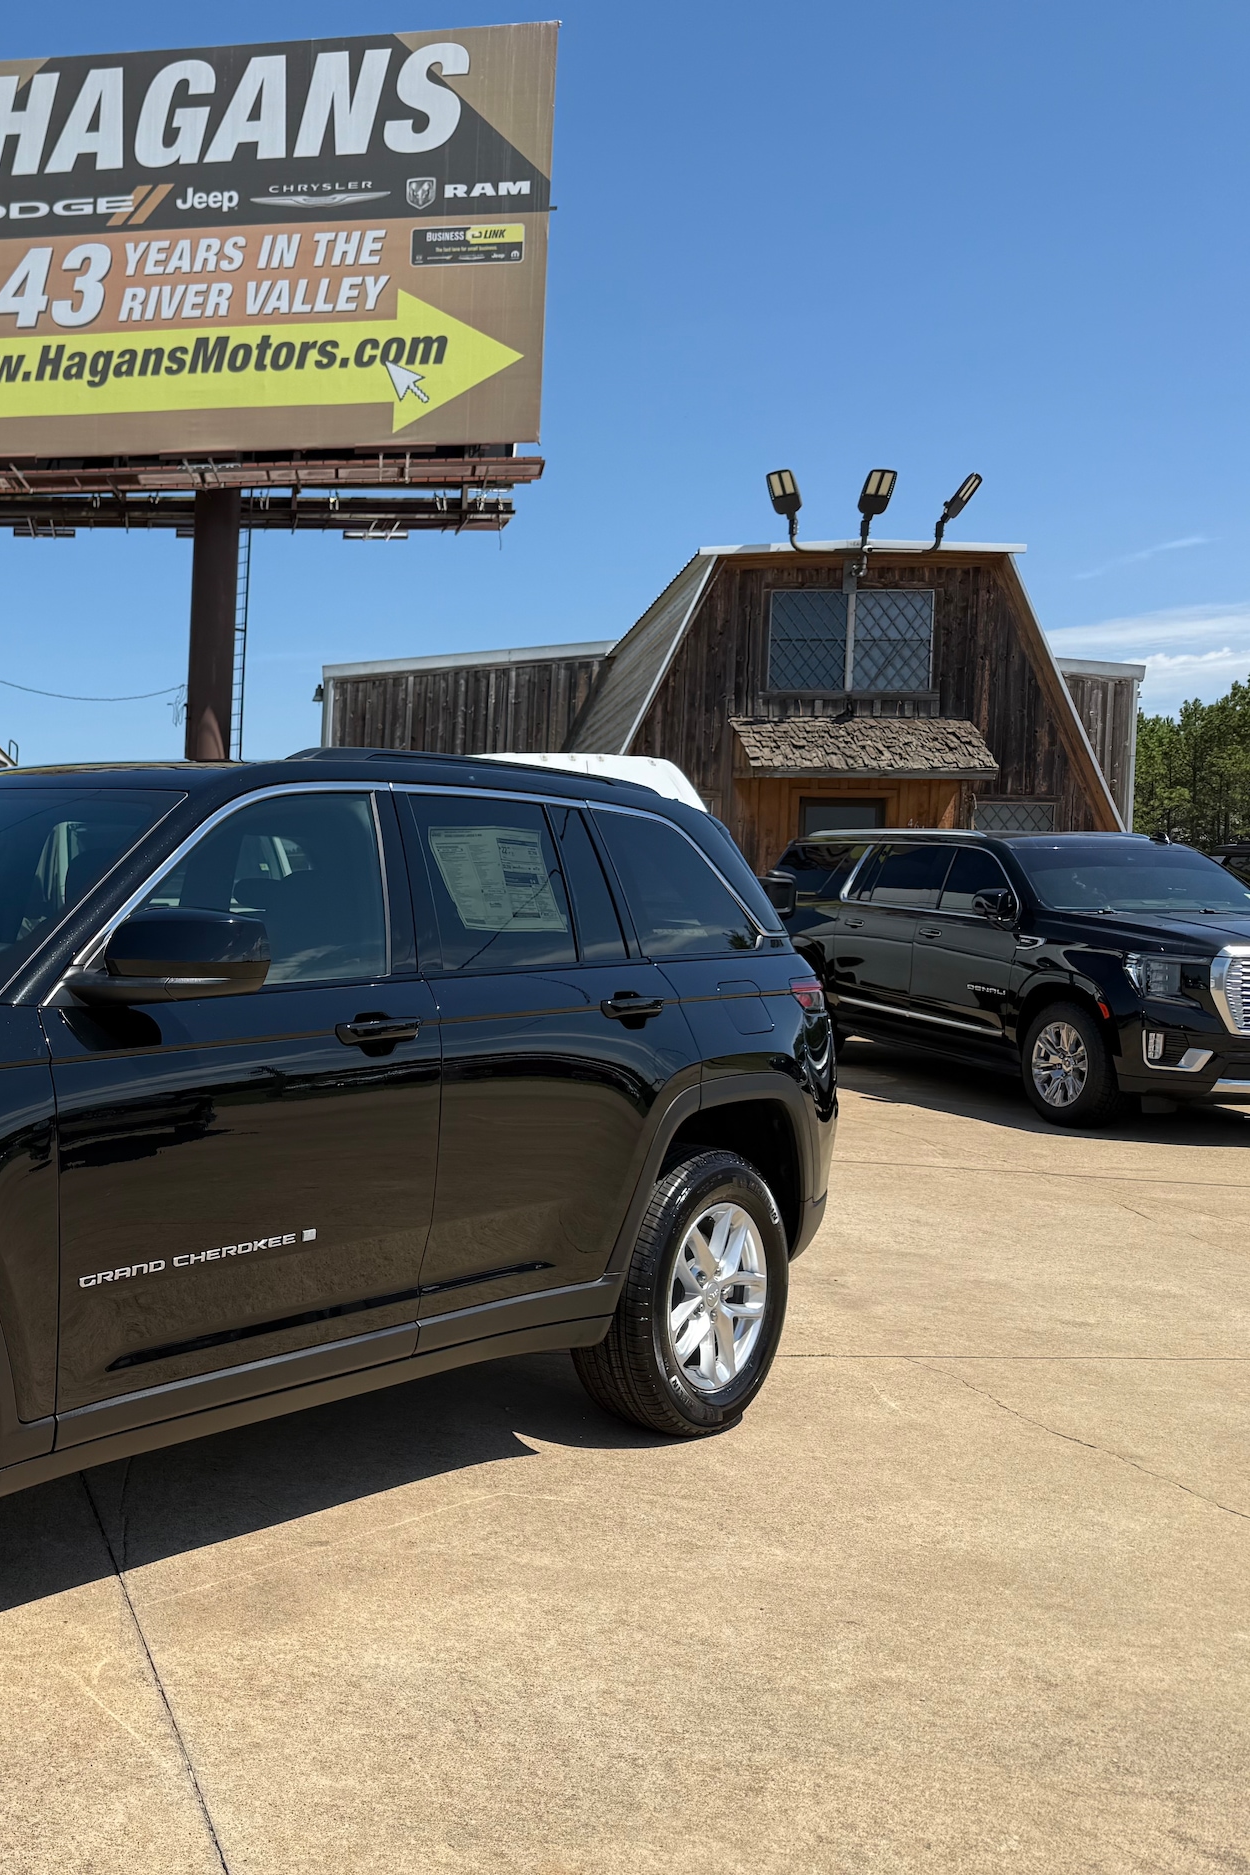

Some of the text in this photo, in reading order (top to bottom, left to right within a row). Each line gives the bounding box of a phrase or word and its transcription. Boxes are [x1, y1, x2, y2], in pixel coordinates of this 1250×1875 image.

[268, 181, 373, 193] CHRYSLER
[443, 180, 531, 199] RAM
[175, 187, 239, 212] Jeep
[426, 229, 506, 242] BUSINESS LINK
[125, 229, 387, 277] YEARS IN THE
[118, 275, 391, 322] RIVER VALLEY
[967, 984, 1006, 995] DENALI
[79, 1233, 297, 1289] GRAND CHEROKEE
